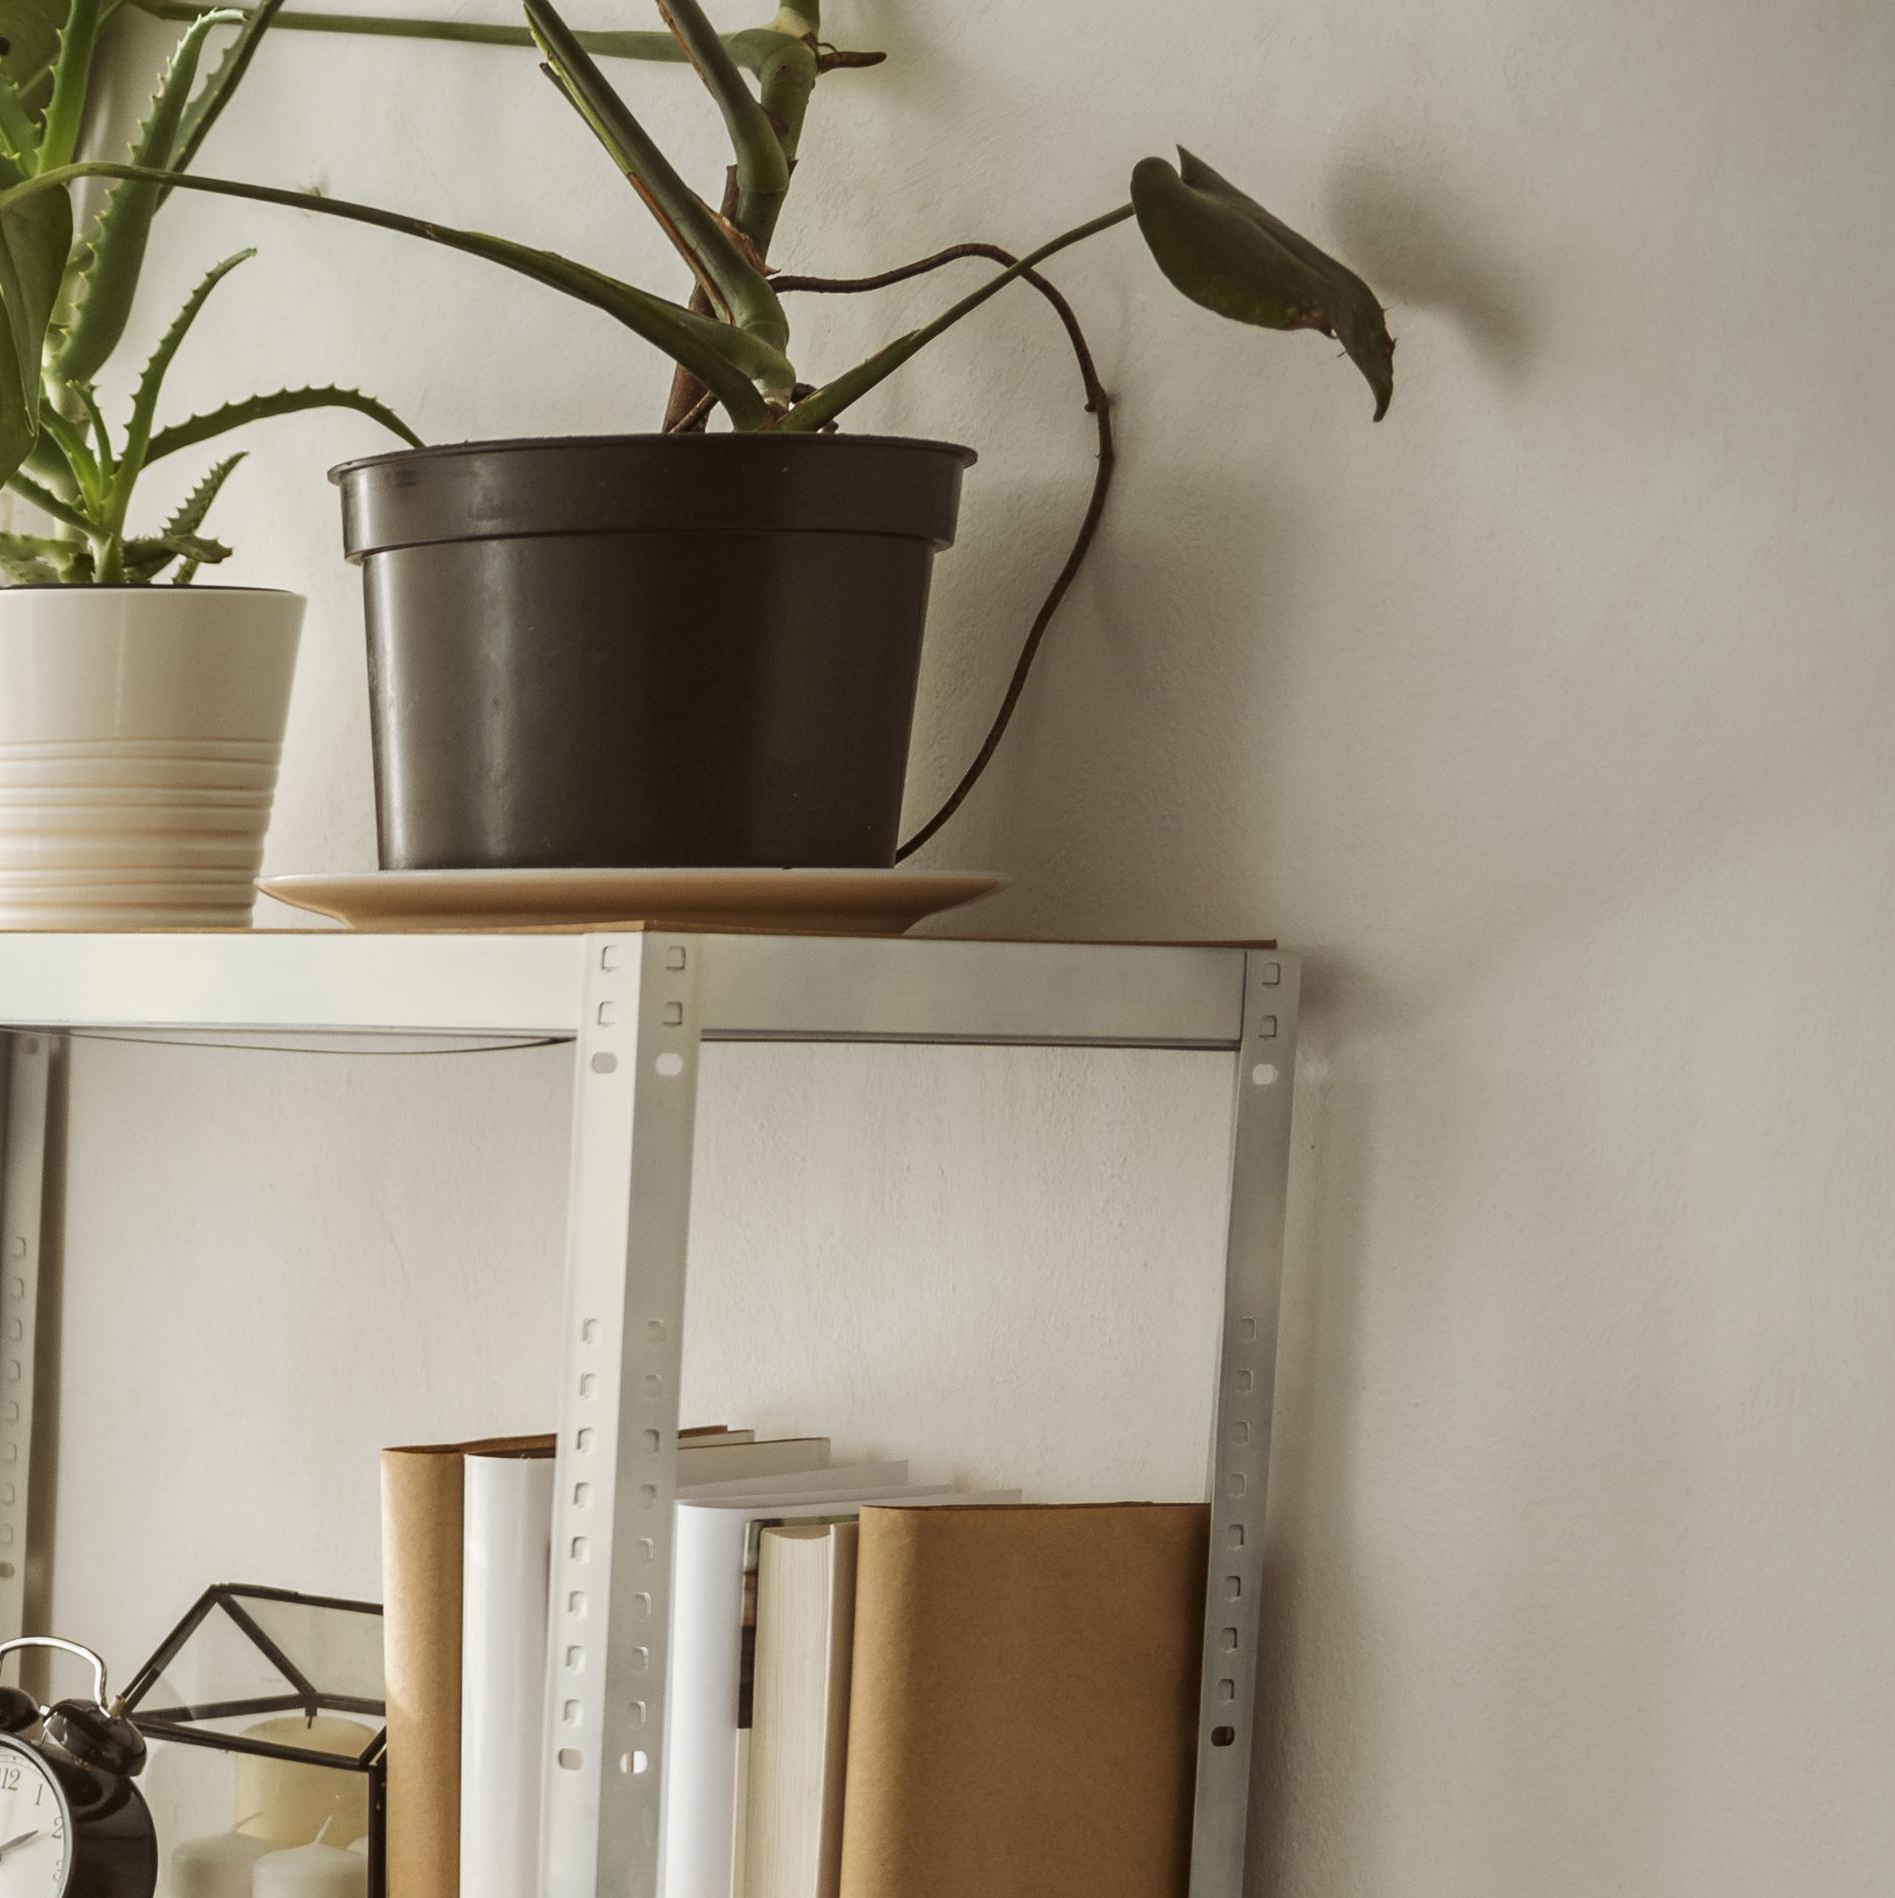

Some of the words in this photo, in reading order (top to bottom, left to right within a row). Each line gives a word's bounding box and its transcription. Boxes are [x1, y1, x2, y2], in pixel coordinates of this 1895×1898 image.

[0, 1767, 21, 1792] 12
[34, 1783, 44, 1807] 1
[51, 1816, 63, 1840] 2
